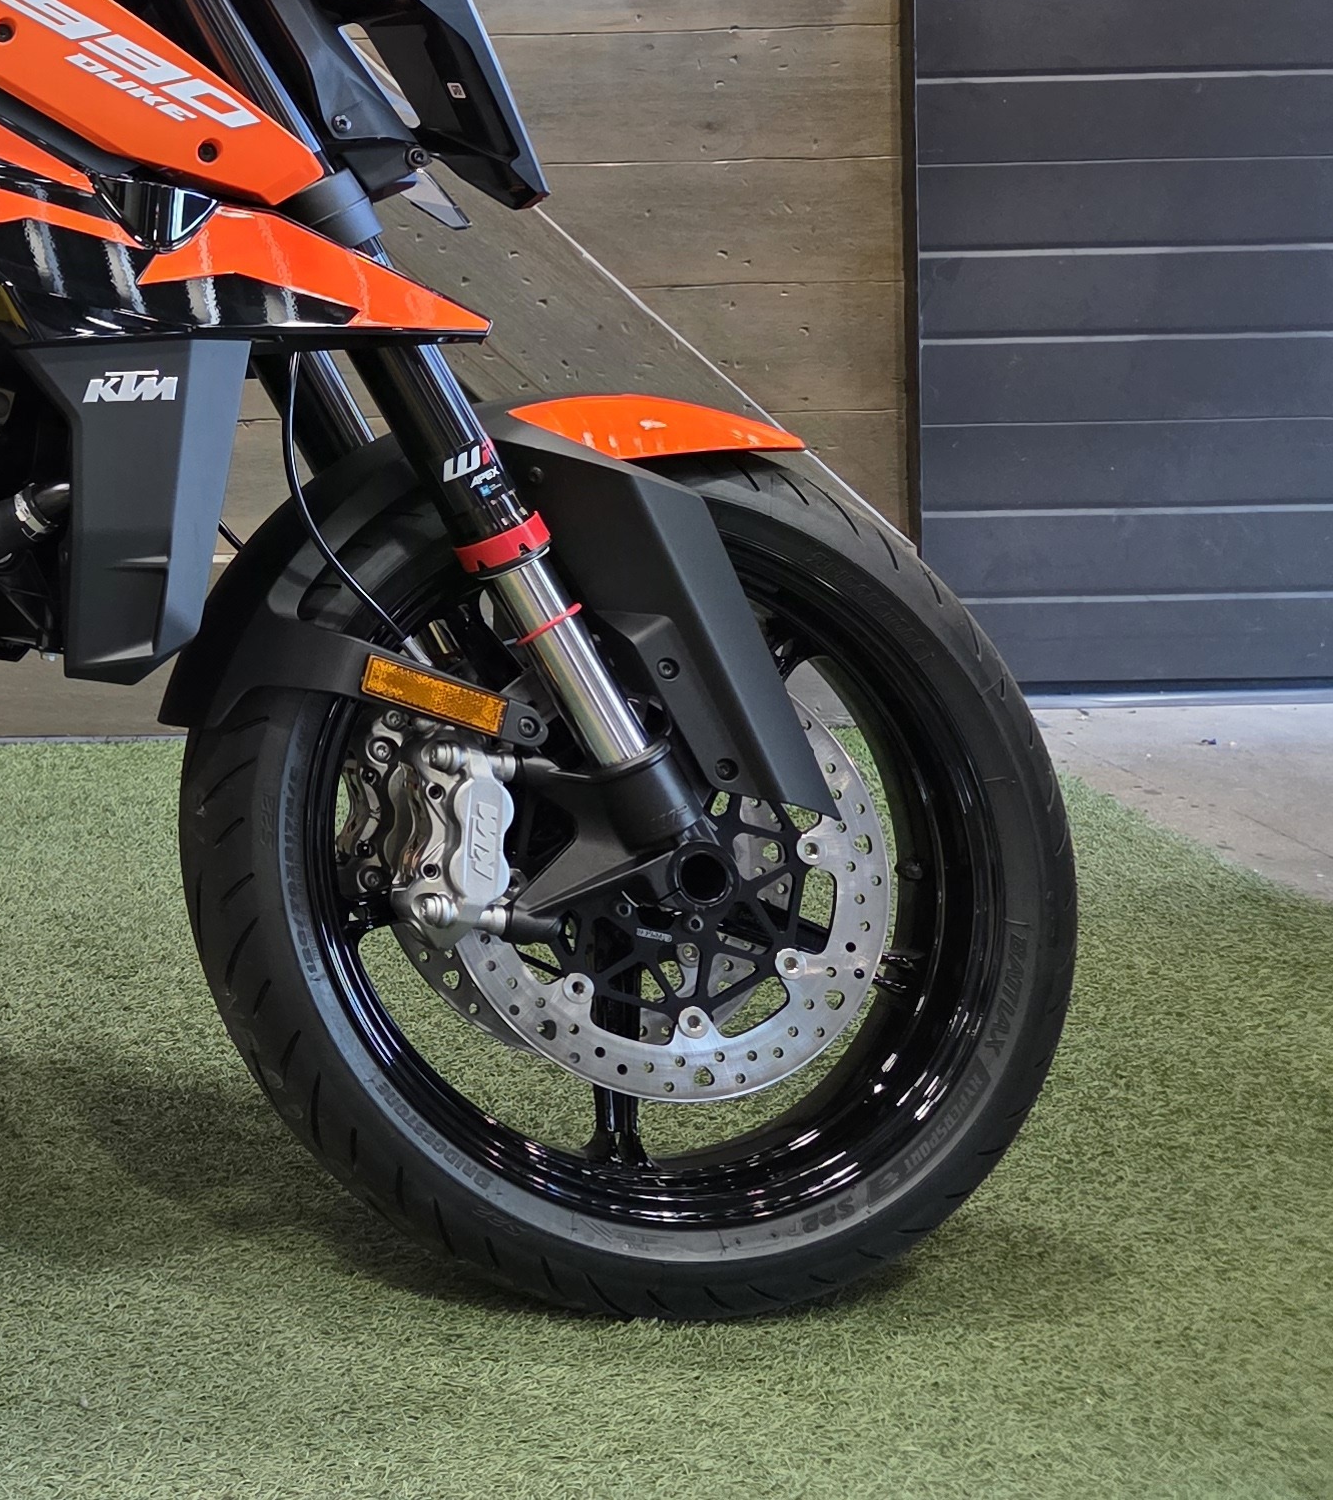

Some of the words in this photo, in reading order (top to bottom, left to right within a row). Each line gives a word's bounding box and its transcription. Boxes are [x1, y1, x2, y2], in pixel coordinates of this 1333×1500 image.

[64, 53, 197, 121] DUKE
[83, 369, 179, 403] KTM
[470, 465, 501, 489] APEX
[469, 801, 498, 881] KTM
[984, 933, 1028, 1056] BATTLAX
[902, 1074, 987, 1178] HYPERSPORT
